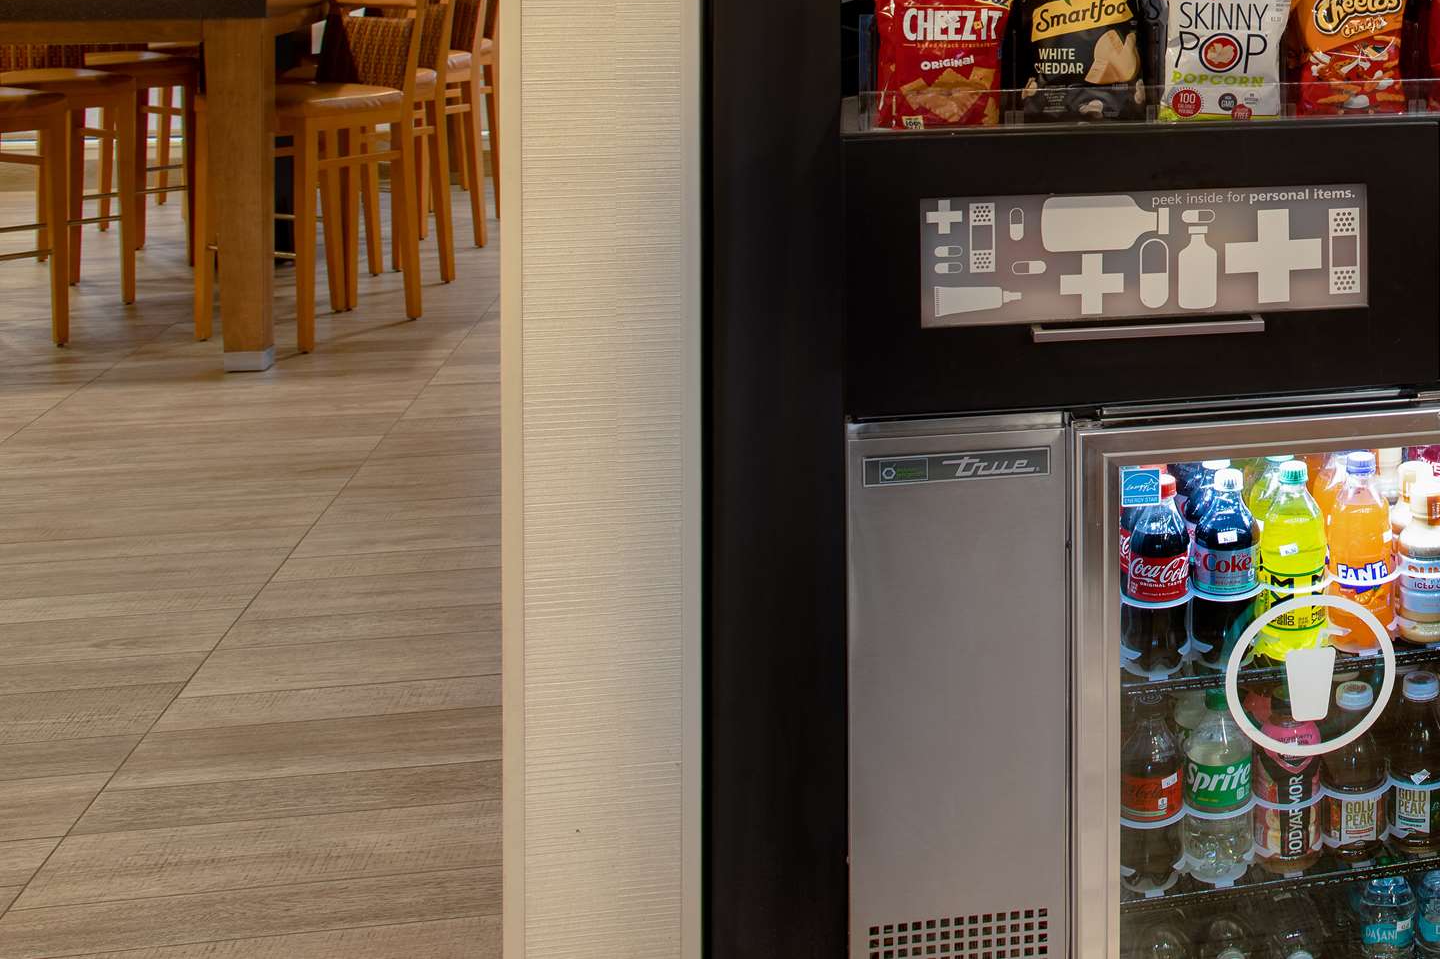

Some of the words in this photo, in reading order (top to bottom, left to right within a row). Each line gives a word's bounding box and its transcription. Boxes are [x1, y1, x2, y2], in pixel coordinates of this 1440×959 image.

[1038, 48, 1076, 60] WHITE
[1174, 30, 1268, 74] POP
[1034, 62, 1084, 75] CHEDDAR
[1171, 70, 1265, 88] POPCORN
[1179, 92, 1196, 104] 100
[1151, 193, 1183, 208] peek
[1186, 191, 1224, 204] inside
[1226, 190, 1246, 203] for
[1249, 188, 1310, 205] personal
[1313, 187, 1356, 201] items.
[942, 455, 1037, 478] true
[1202, 553, 1252, 574] Coke
[1337, 561, 1389, 582] FANTA
[1187, 760, 1251, 793] Sprite
[1399, 789, 1427, 802] GOLD
[1345, 800, 1375, 814] GOLD
[1399, 801, 1426, 815] PEAK
[1345, 811, 1375, 827] PEAK
